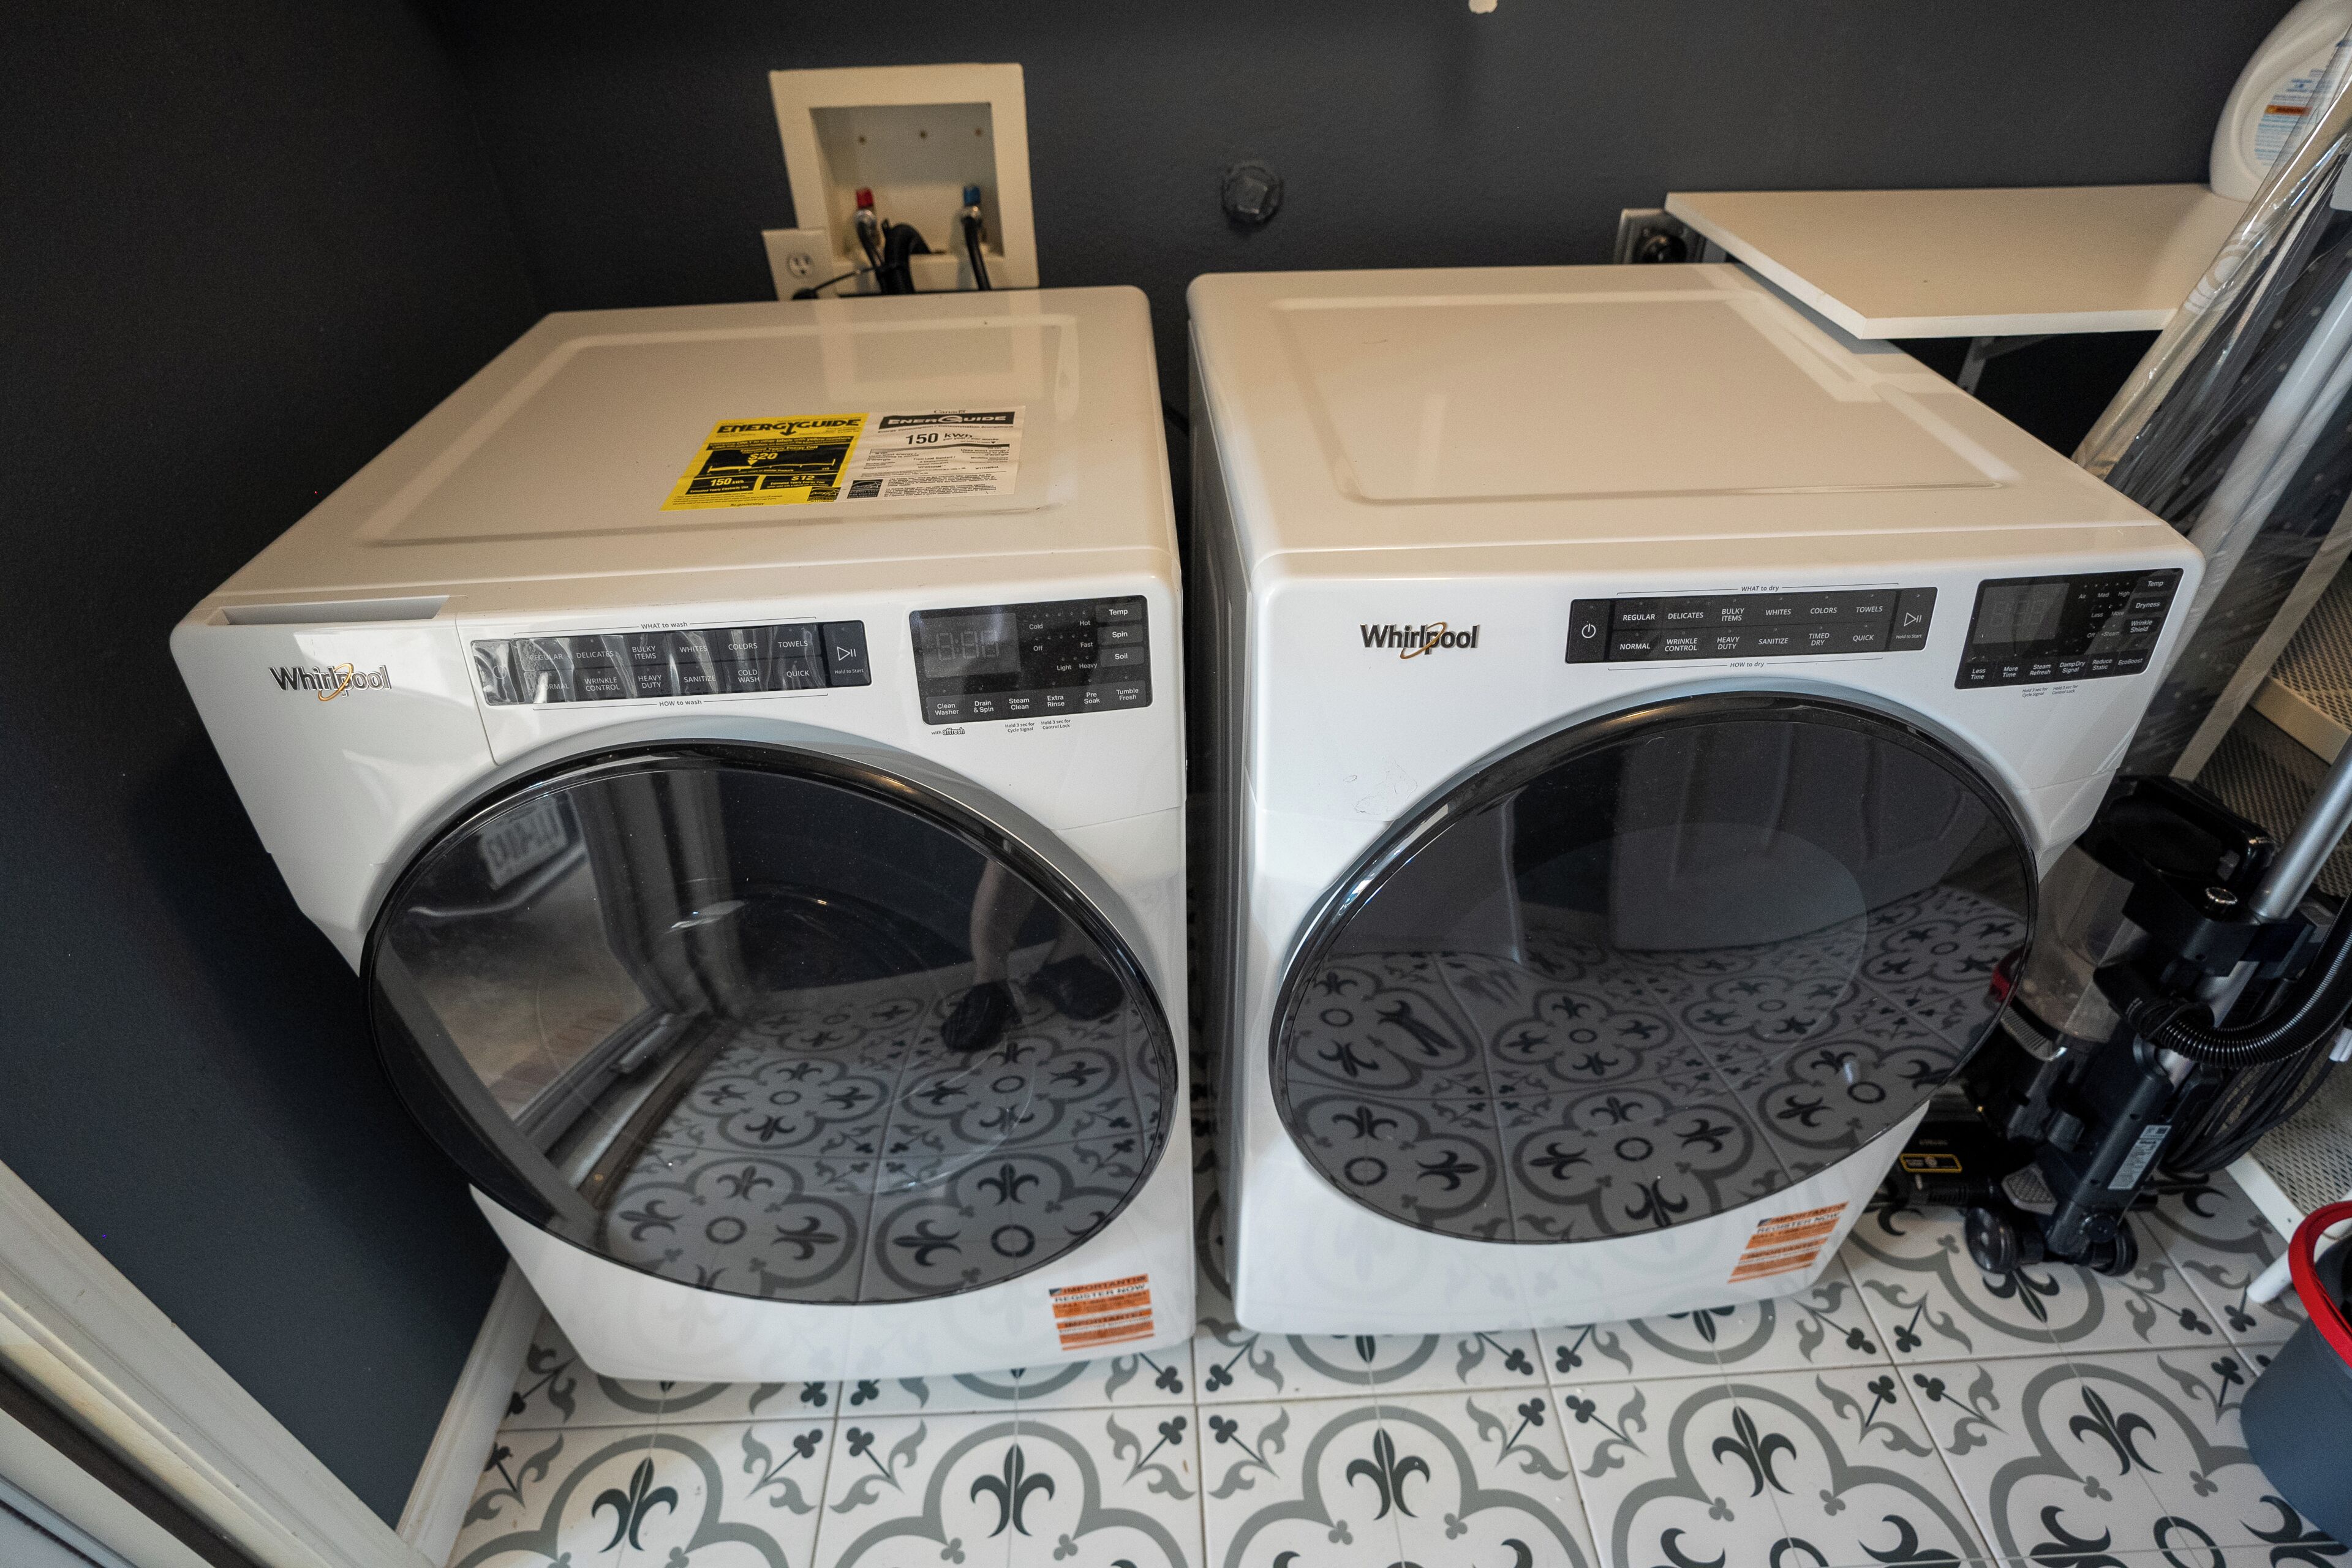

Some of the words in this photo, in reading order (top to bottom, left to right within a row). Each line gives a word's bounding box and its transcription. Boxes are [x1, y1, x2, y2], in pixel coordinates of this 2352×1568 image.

[717, 418, 861, 434] ENERGYGUIDE
[906, 433, 938, 445] 150
[710, 478, 732, 486] 150
[1360, 624, 1480, 655] Whirlpool
[269, 665, 391, 697] Whirlpool
